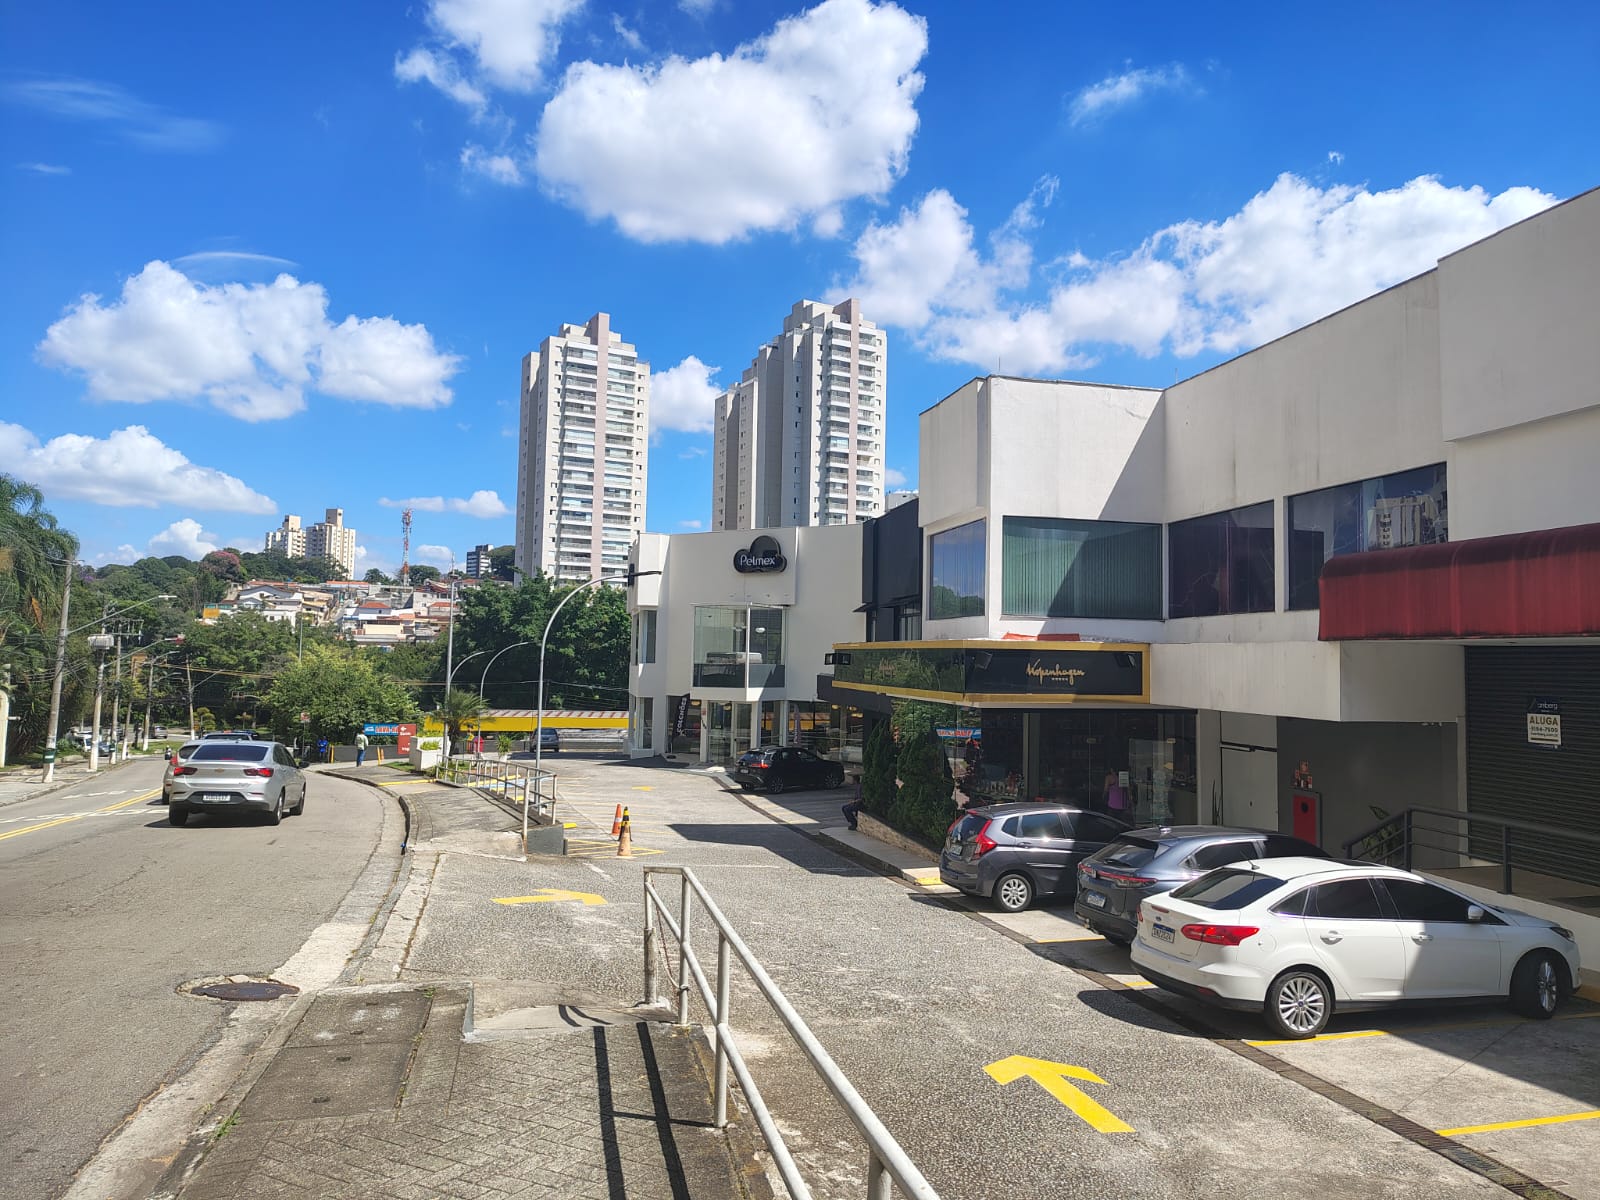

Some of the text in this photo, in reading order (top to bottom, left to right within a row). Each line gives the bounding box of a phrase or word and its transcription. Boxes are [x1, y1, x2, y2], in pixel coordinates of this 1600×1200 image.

[740, 554, 776, 567] Pelmex
[1025, 658, 1086, 686] Kopenhagen
[1529, 715, 1559, 726] ALUGA
